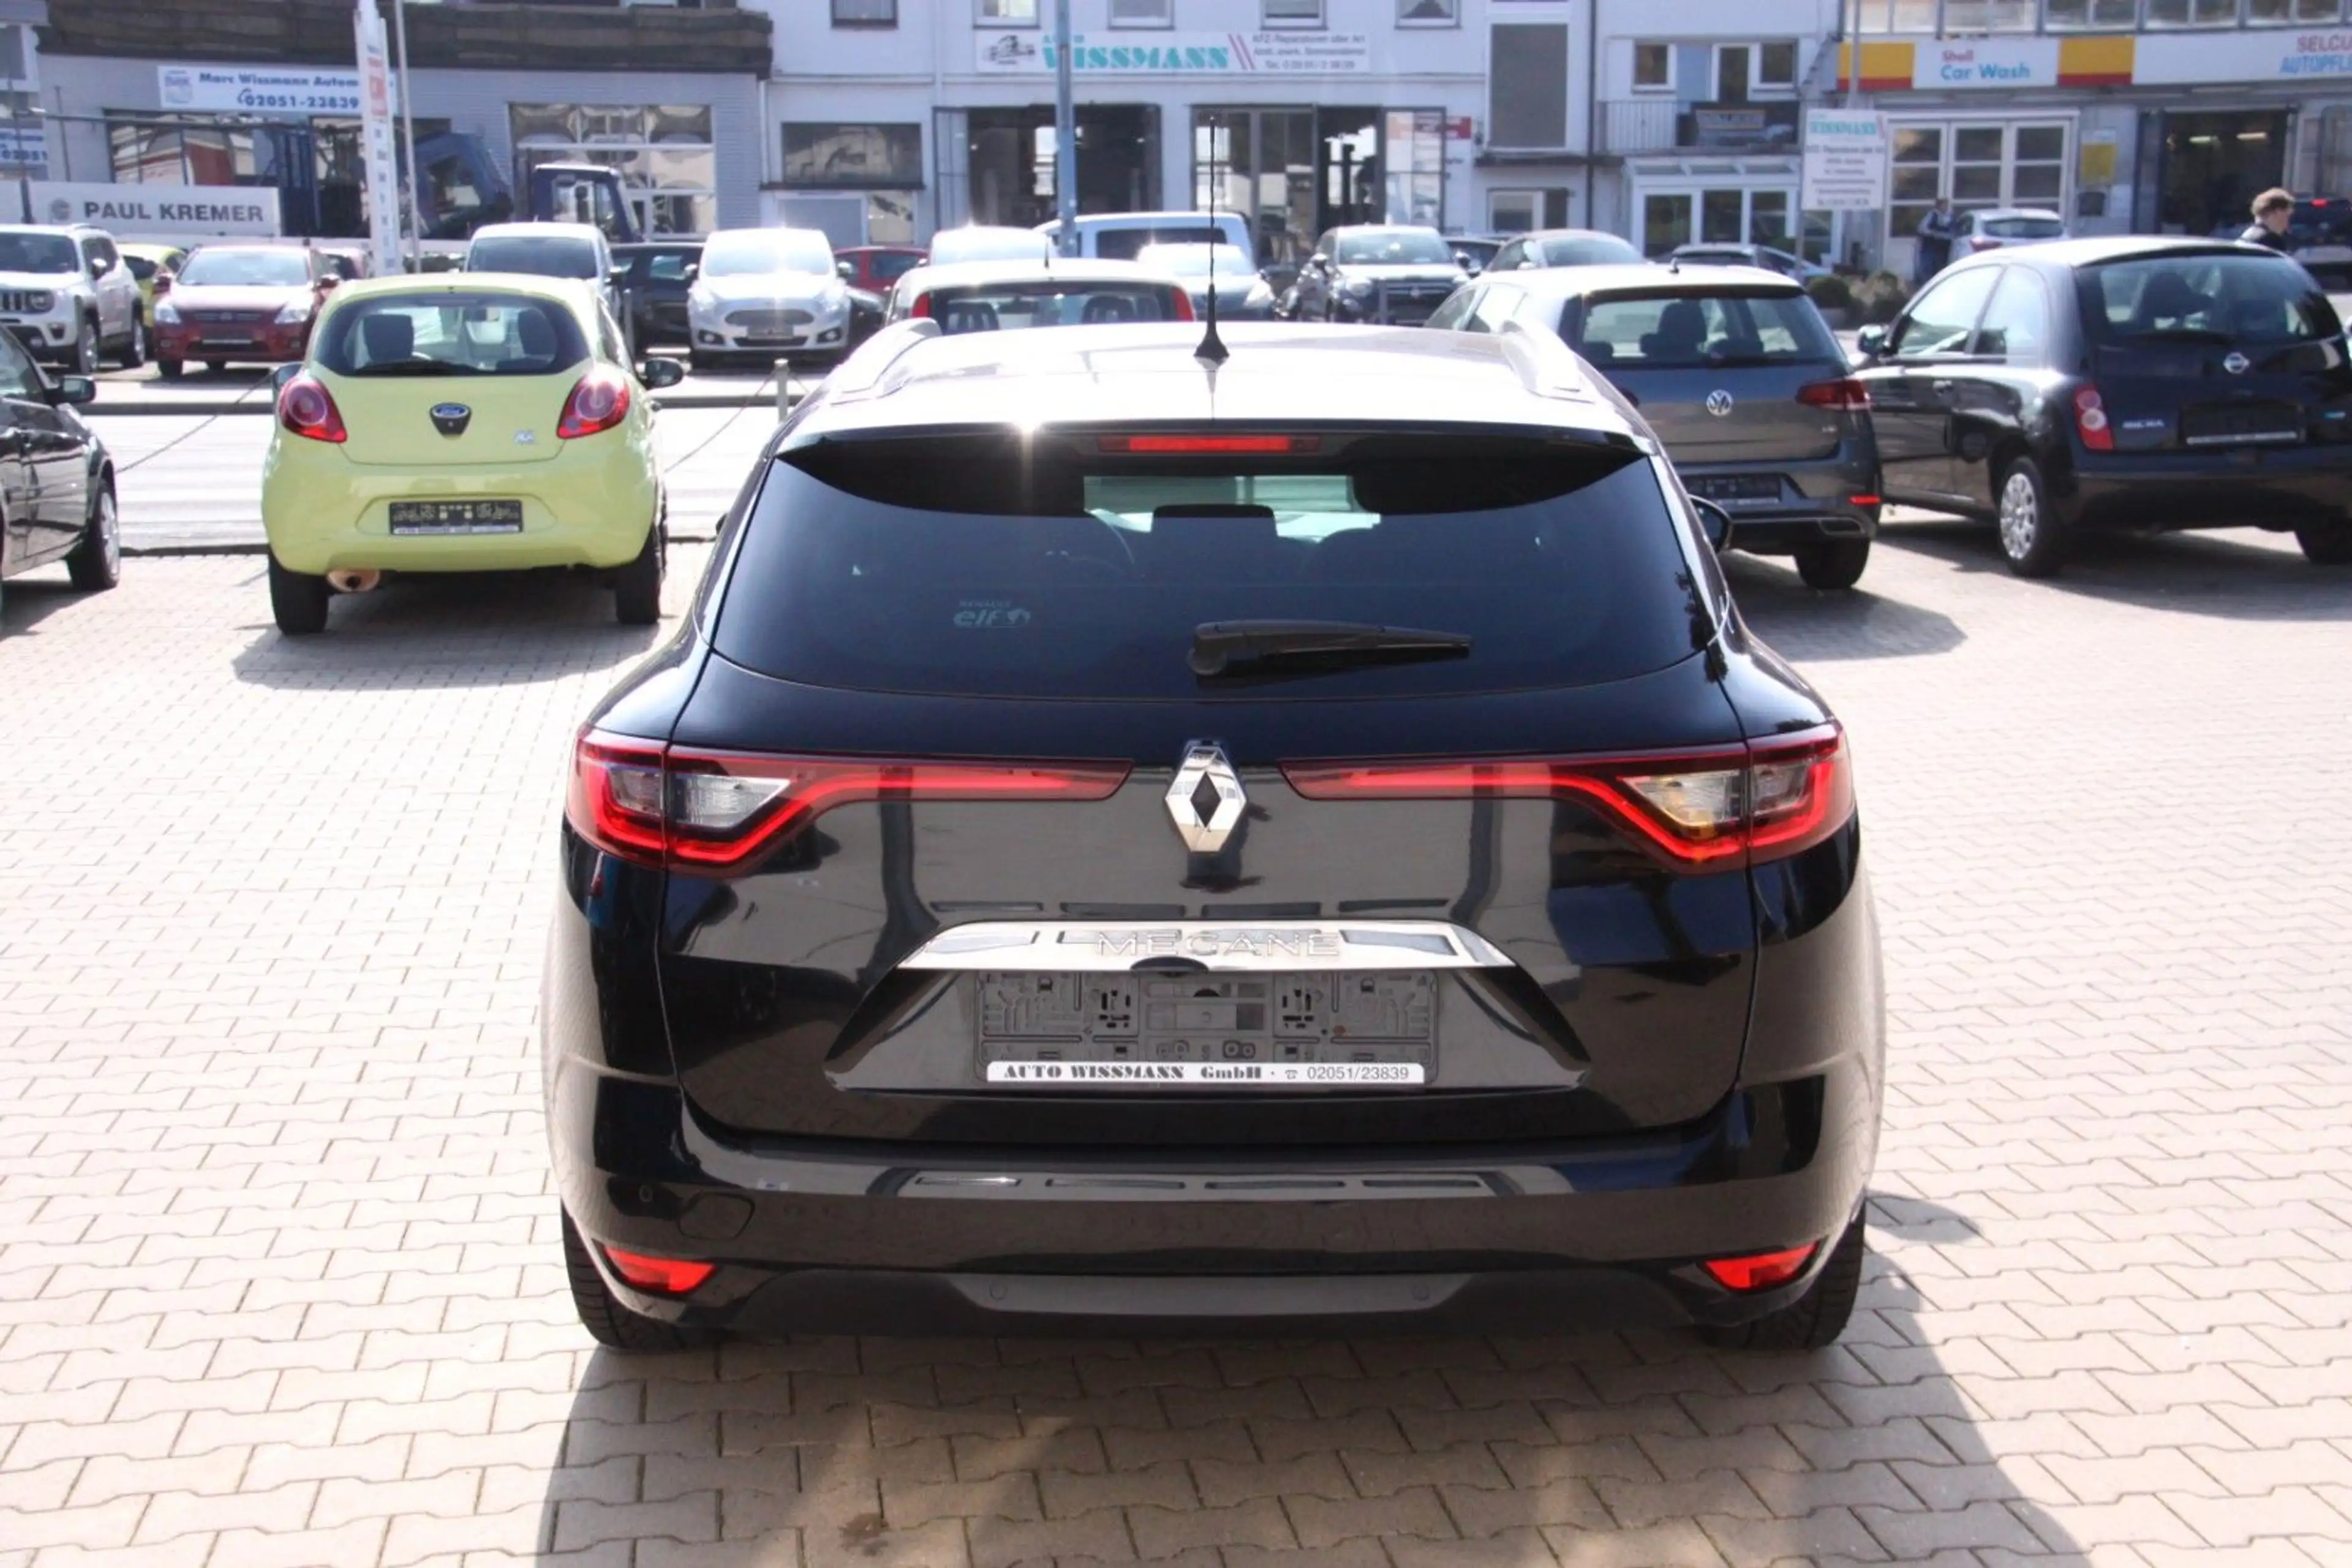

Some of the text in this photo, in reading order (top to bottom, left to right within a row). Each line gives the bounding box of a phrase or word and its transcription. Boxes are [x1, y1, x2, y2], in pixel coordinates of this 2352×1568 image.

[199, 72, 235, 85] Marc
[1940, 62, 2030, 80] Car Wash
[83, 202, 264, 222] PAUL KREMER
[1095, 930, 1340, 956] MEGANE
[1004, 1065, 1409, 1080] AUTO WISSMANN GmbH 02051/23839
